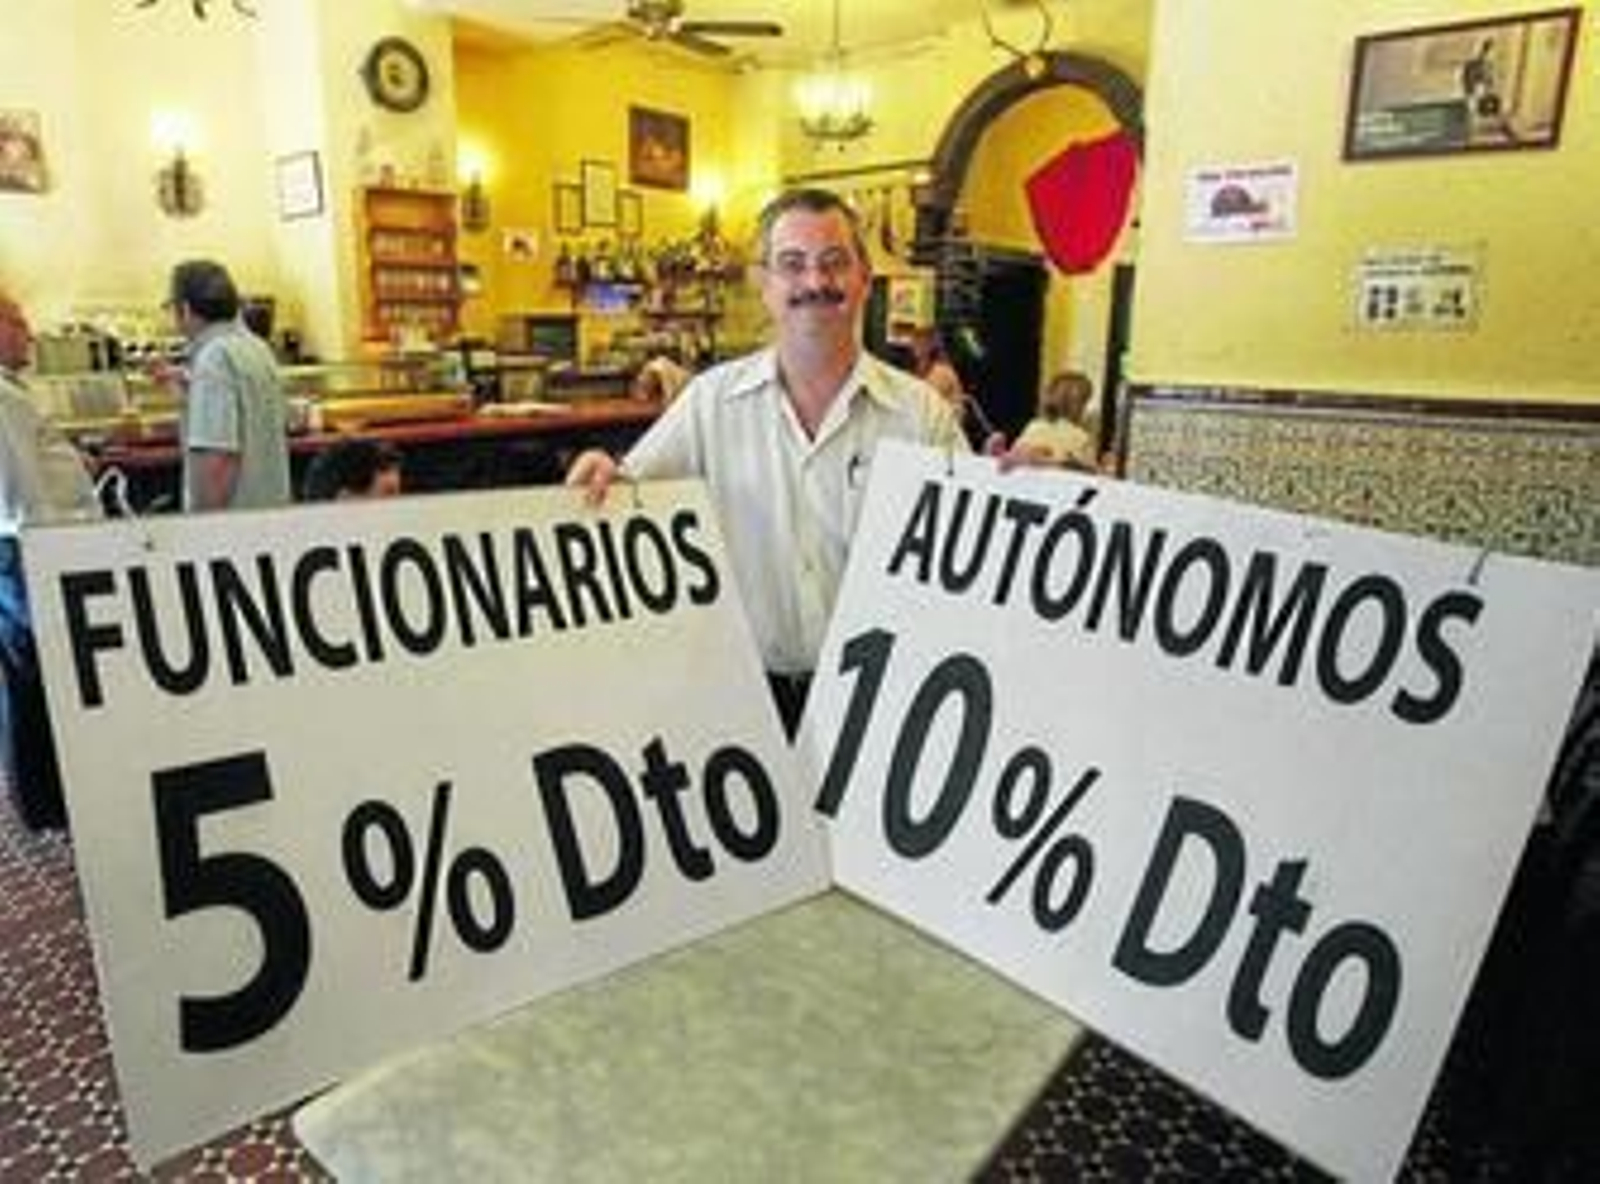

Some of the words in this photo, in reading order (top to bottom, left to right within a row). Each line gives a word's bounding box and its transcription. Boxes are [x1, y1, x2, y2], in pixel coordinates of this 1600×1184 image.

[59, 509, 721, 709] FUNCIONARIOS
[886, 480, 1485, 725] AUTÓNOMOS
[532, 737, 782, 922] Dto
[813, 628, 1101, 933] 10%
[1111, 796, 1403, 1082] Dto
